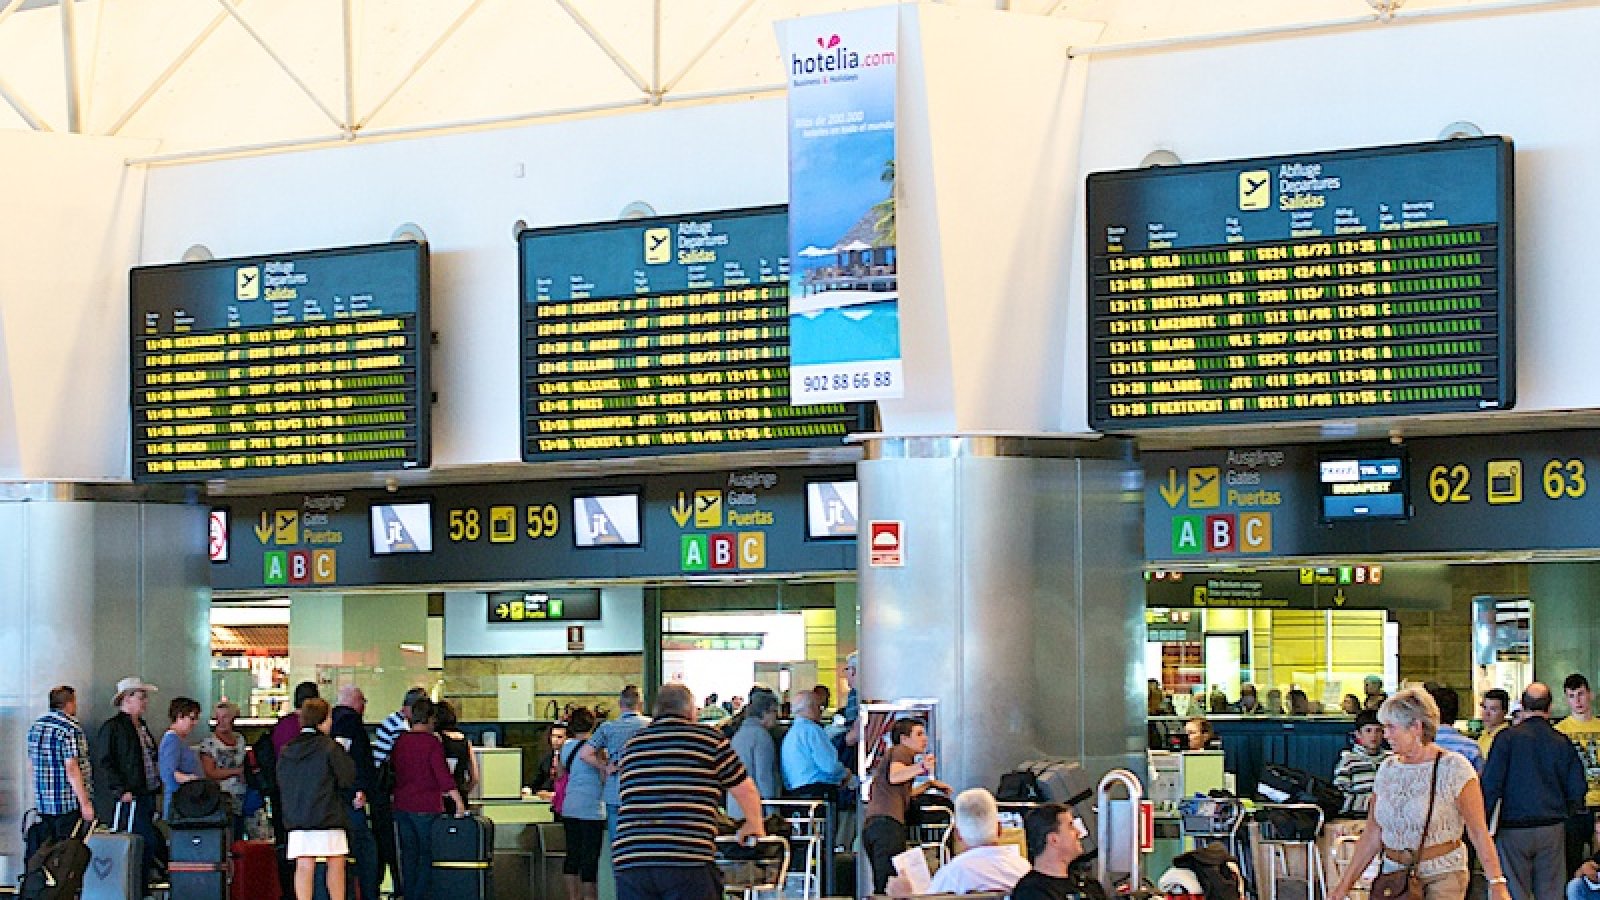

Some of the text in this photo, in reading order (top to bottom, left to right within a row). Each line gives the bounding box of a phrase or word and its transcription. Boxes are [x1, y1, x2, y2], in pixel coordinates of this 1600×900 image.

[791, 47, 896, 75] hotelia.com
[1280, 177, 1341, 193] Departures
[1280, 193, 1326, 210] Salidas
[678, 248, 717, 265] Salidas
[1110, 298, 1146, 313] 13:15
[1110, 319, 1146, 334] 13:15
[1110, 340, 1146, 355] 13:15
[1151, 337, 1195, 352] MALAGA
[1110, 361, 1146, 376] 13:15
[1151, 358, 1195, 373] MALAGA
[804, 371, 892, 392] 902 88 66 88
[1226, 469, 1261, 485] Gates
[1428, 465, 1471, 504] 62
[1543, 459, 1587, 500] 63
[728, 491, 757, 504] Gates
[1227, 489, 1282, 506] Puertas
[449, 509, 481, 541] 58
[526, 503, 560, 539] 59
[728, 510, 775, 526] Puertas
[303, 530, 343, 543] Puertas
[1180, 518, 1263, 547] A B C
[686, 539, 757, 564] A B C
[269, 553, 330, 578] A B C
